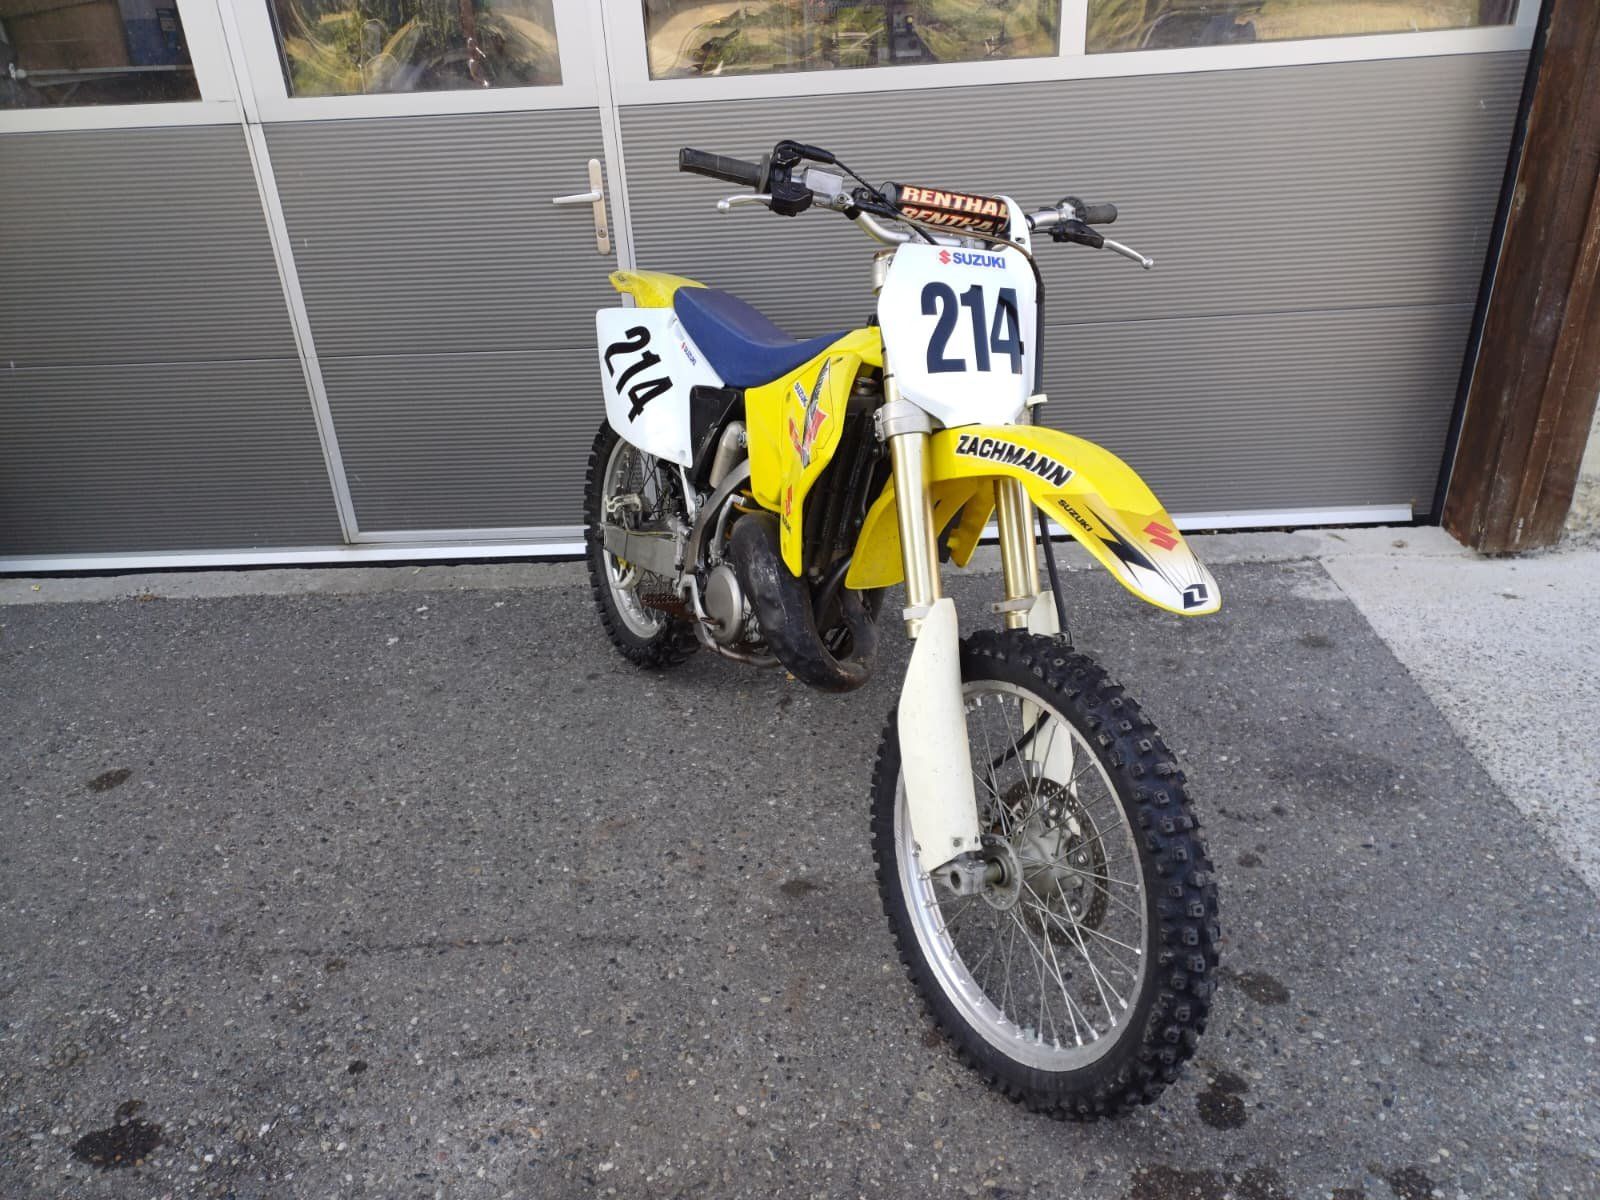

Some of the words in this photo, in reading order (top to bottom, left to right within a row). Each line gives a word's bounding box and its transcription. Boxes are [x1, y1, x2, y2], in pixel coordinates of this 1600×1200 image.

[902, 186, 1009, 218] RENTHAL
[952, 252, 1006, 269] SUZUKI
[920, 281, 1024, 375] 214
[604, 325, 673, 424] 214
[955, 434, 1073, 487] ZACHMANN
[1057, 499, 1094, 532] SUZUKI
